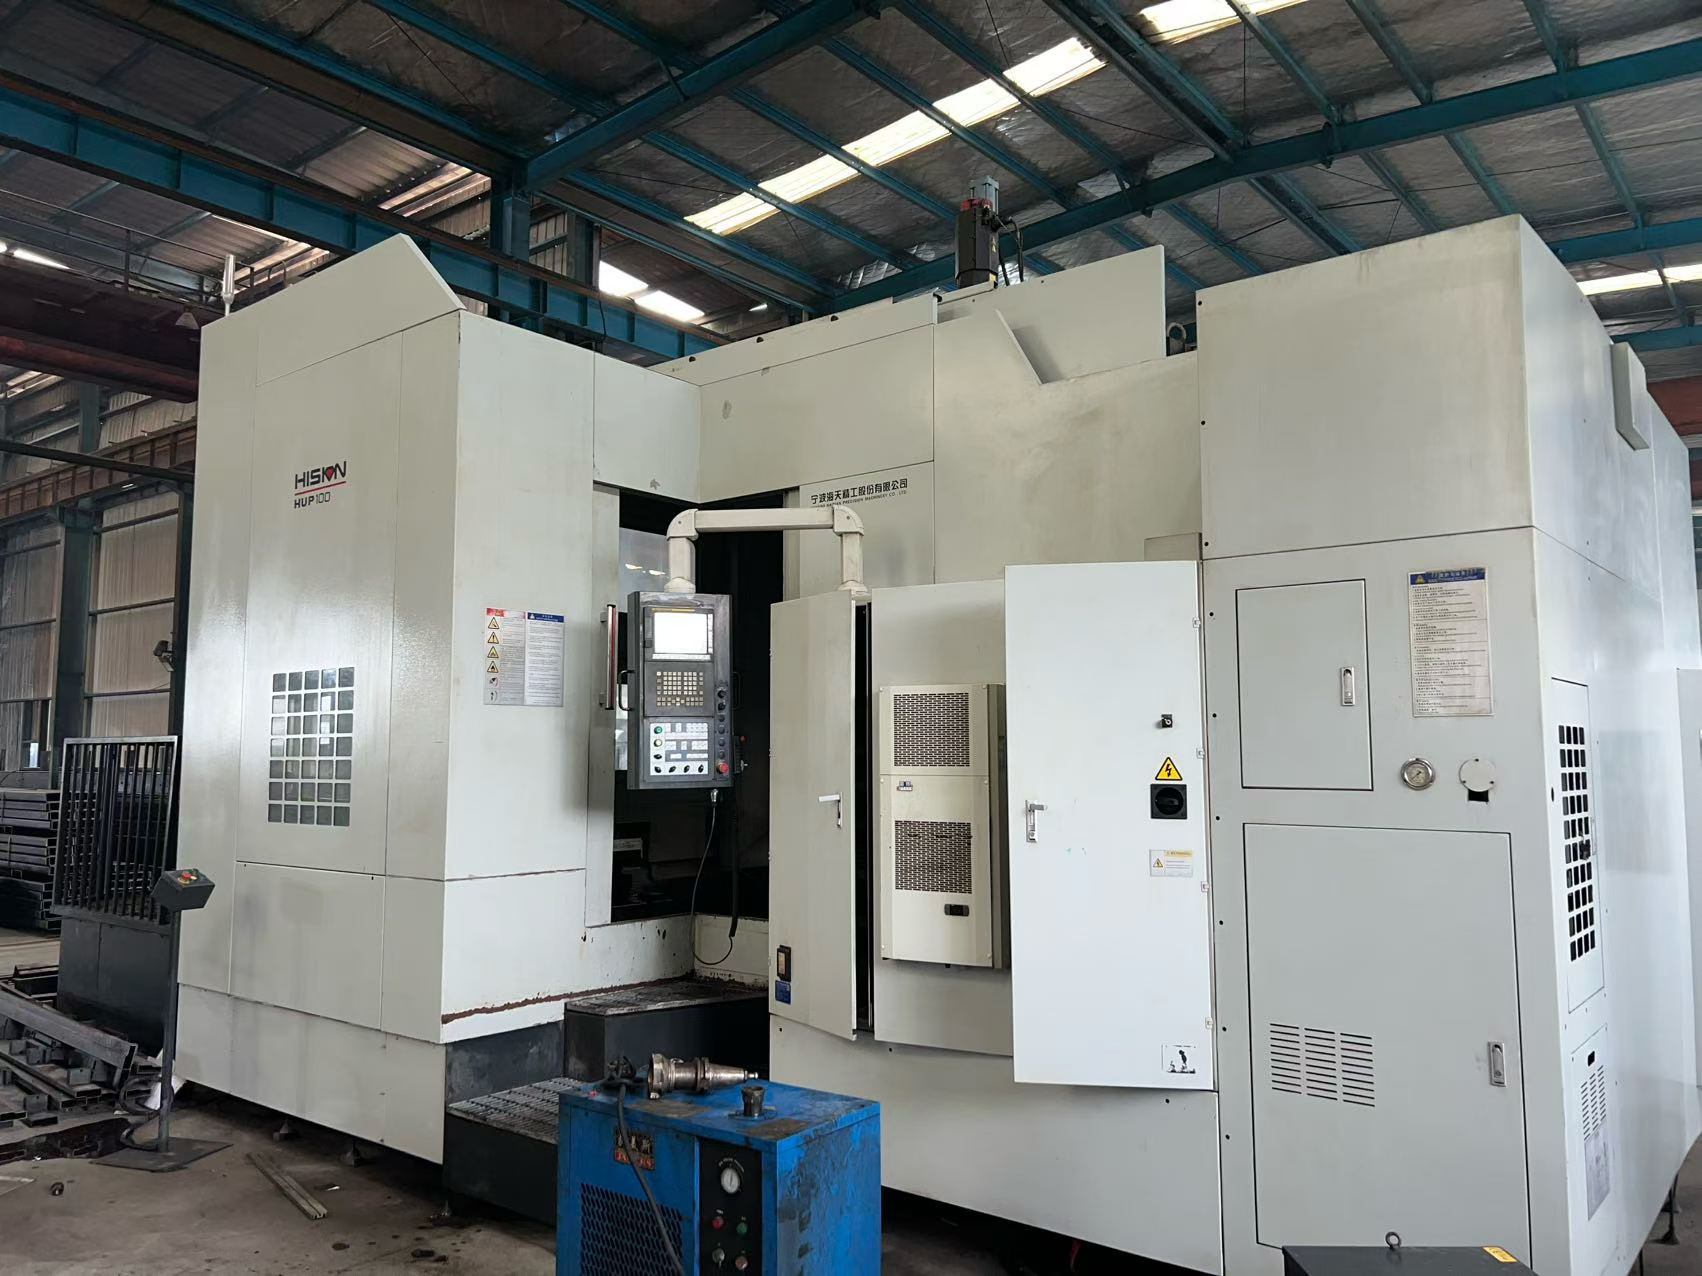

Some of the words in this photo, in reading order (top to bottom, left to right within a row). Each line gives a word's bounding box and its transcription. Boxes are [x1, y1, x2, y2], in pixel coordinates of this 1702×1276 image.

[811, 479, 908, 505] 宁波海天精工股份有限公司
